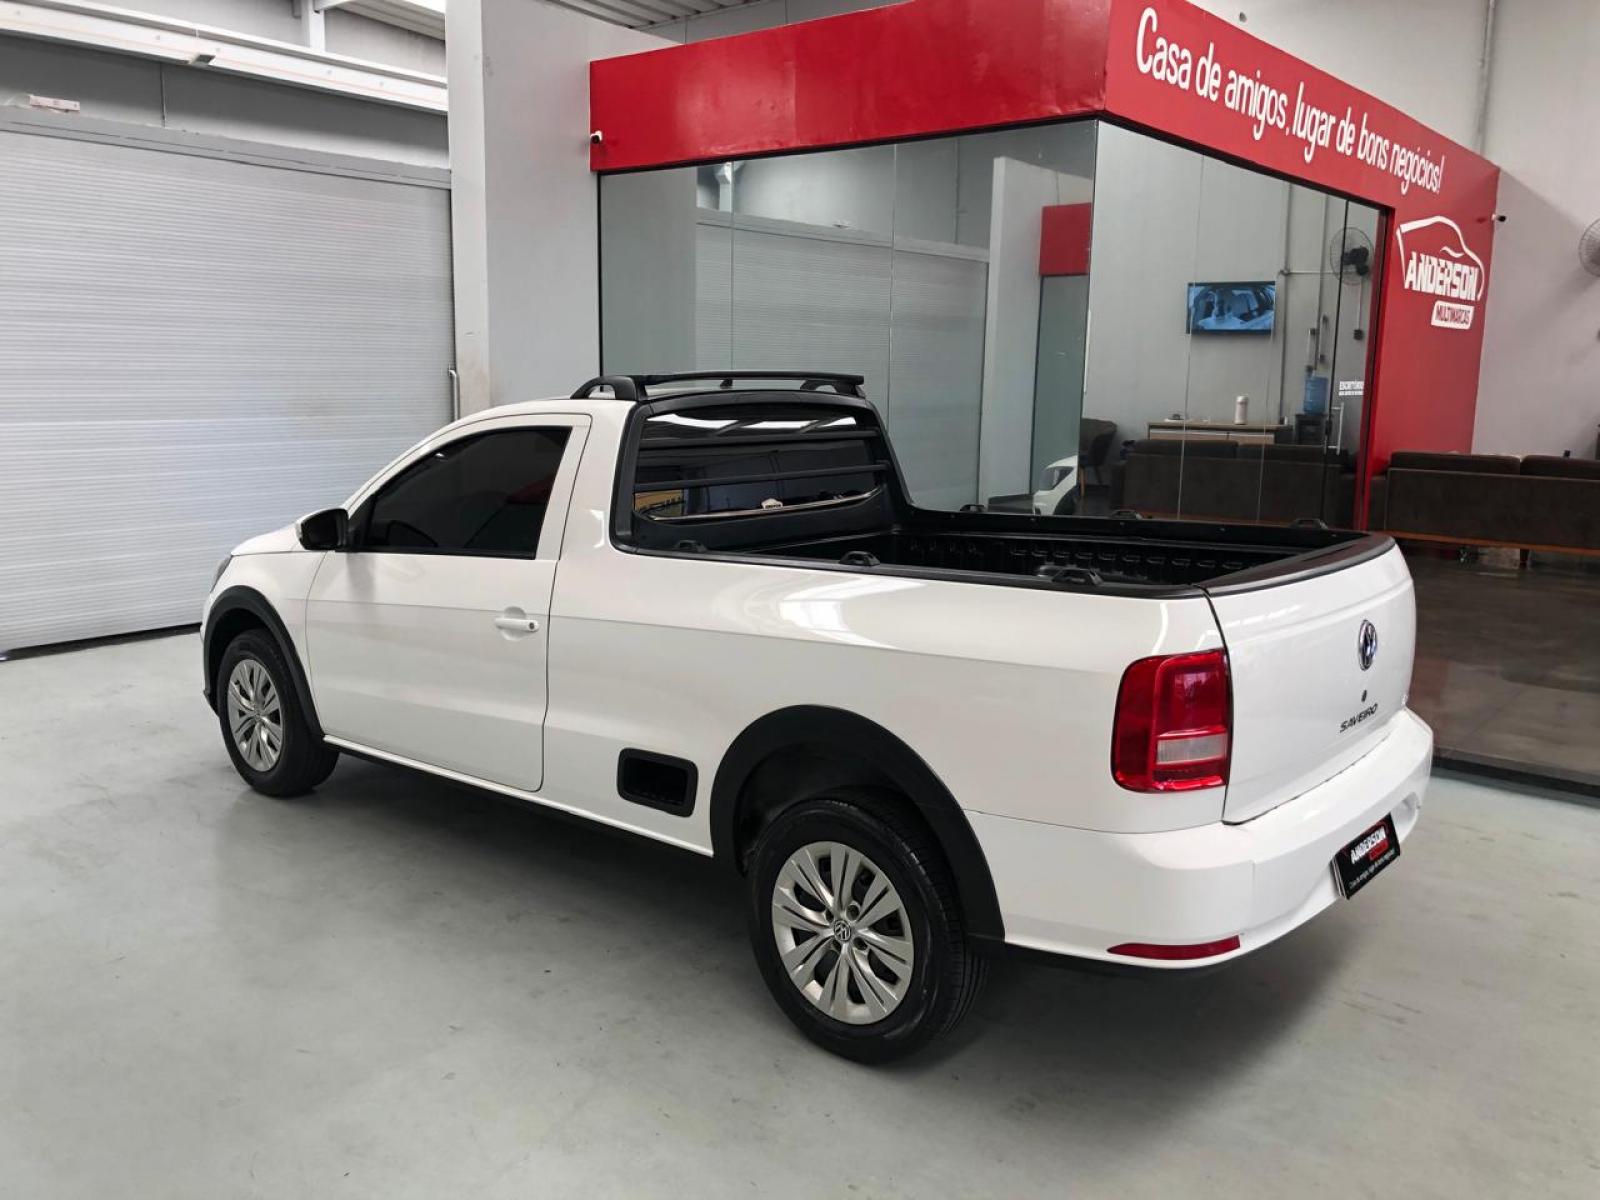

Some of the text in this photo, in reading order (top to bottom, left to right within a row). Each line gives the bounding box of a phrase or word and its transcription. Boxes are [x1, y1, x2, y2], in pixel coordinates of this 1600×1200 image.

[1136, 8, 1445, 194] Casa de amigos, lugar de bons negócios!
[1405, 251, 1479, 301] ANDERSON
[1340, 703, 1378, 733] SAVEIRO
